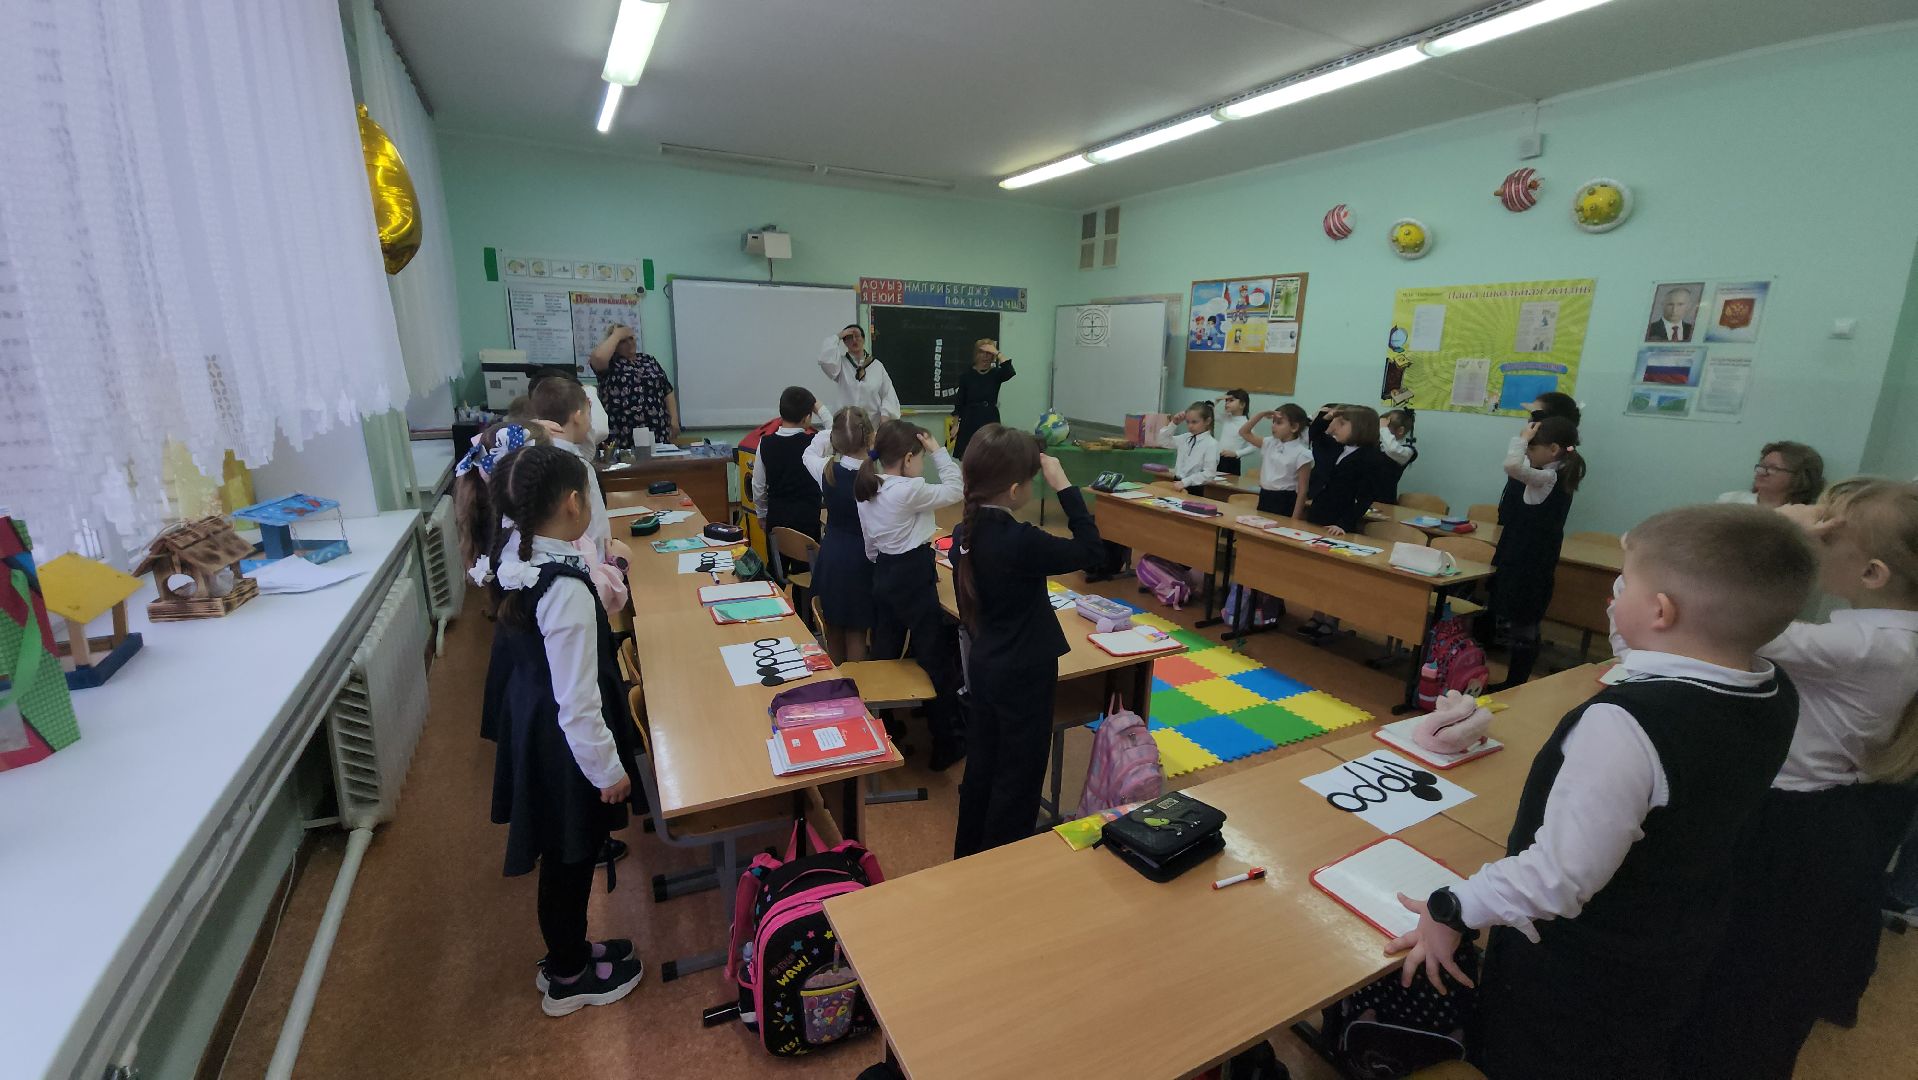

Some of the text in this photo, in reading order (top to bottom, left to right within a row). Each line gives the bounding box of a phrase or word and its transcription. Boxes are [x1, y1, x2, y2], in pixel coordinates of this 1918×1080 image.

[1482, 287, 1544, 299] школьная
[1546, 285, 1591, 296] жизнь
[776, 955, 813, 988] WAW!
[778, 1036, 801, 1054] YES!
